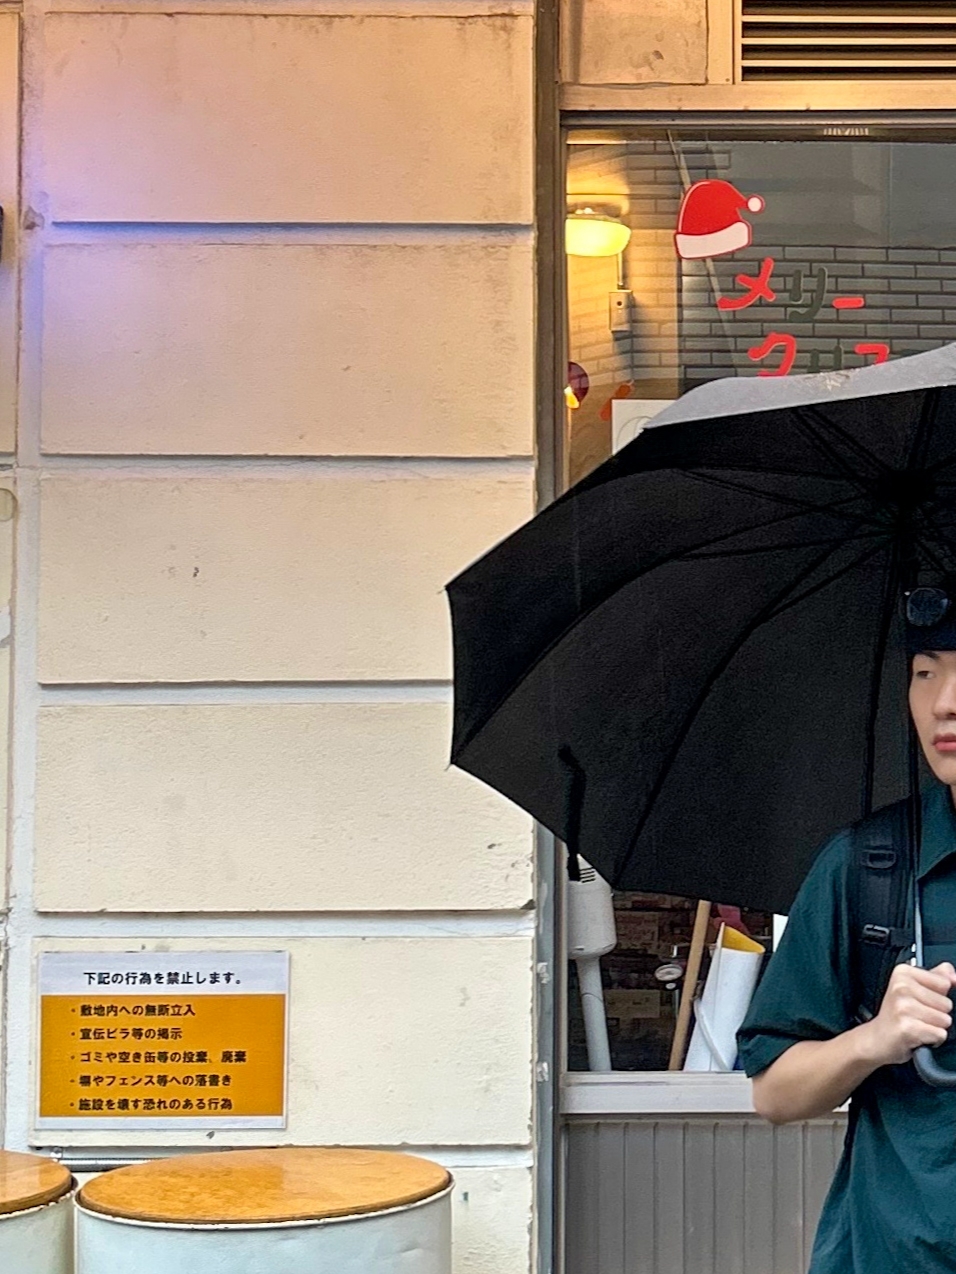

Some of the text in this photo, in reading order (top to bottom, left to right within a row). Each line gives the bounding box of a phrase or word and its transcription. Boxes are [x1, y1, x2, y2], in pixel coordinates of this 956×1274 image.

[717, 257, 864, 322] メリー
[83, 971, 242, 985] 下記の行為を禁止します。
